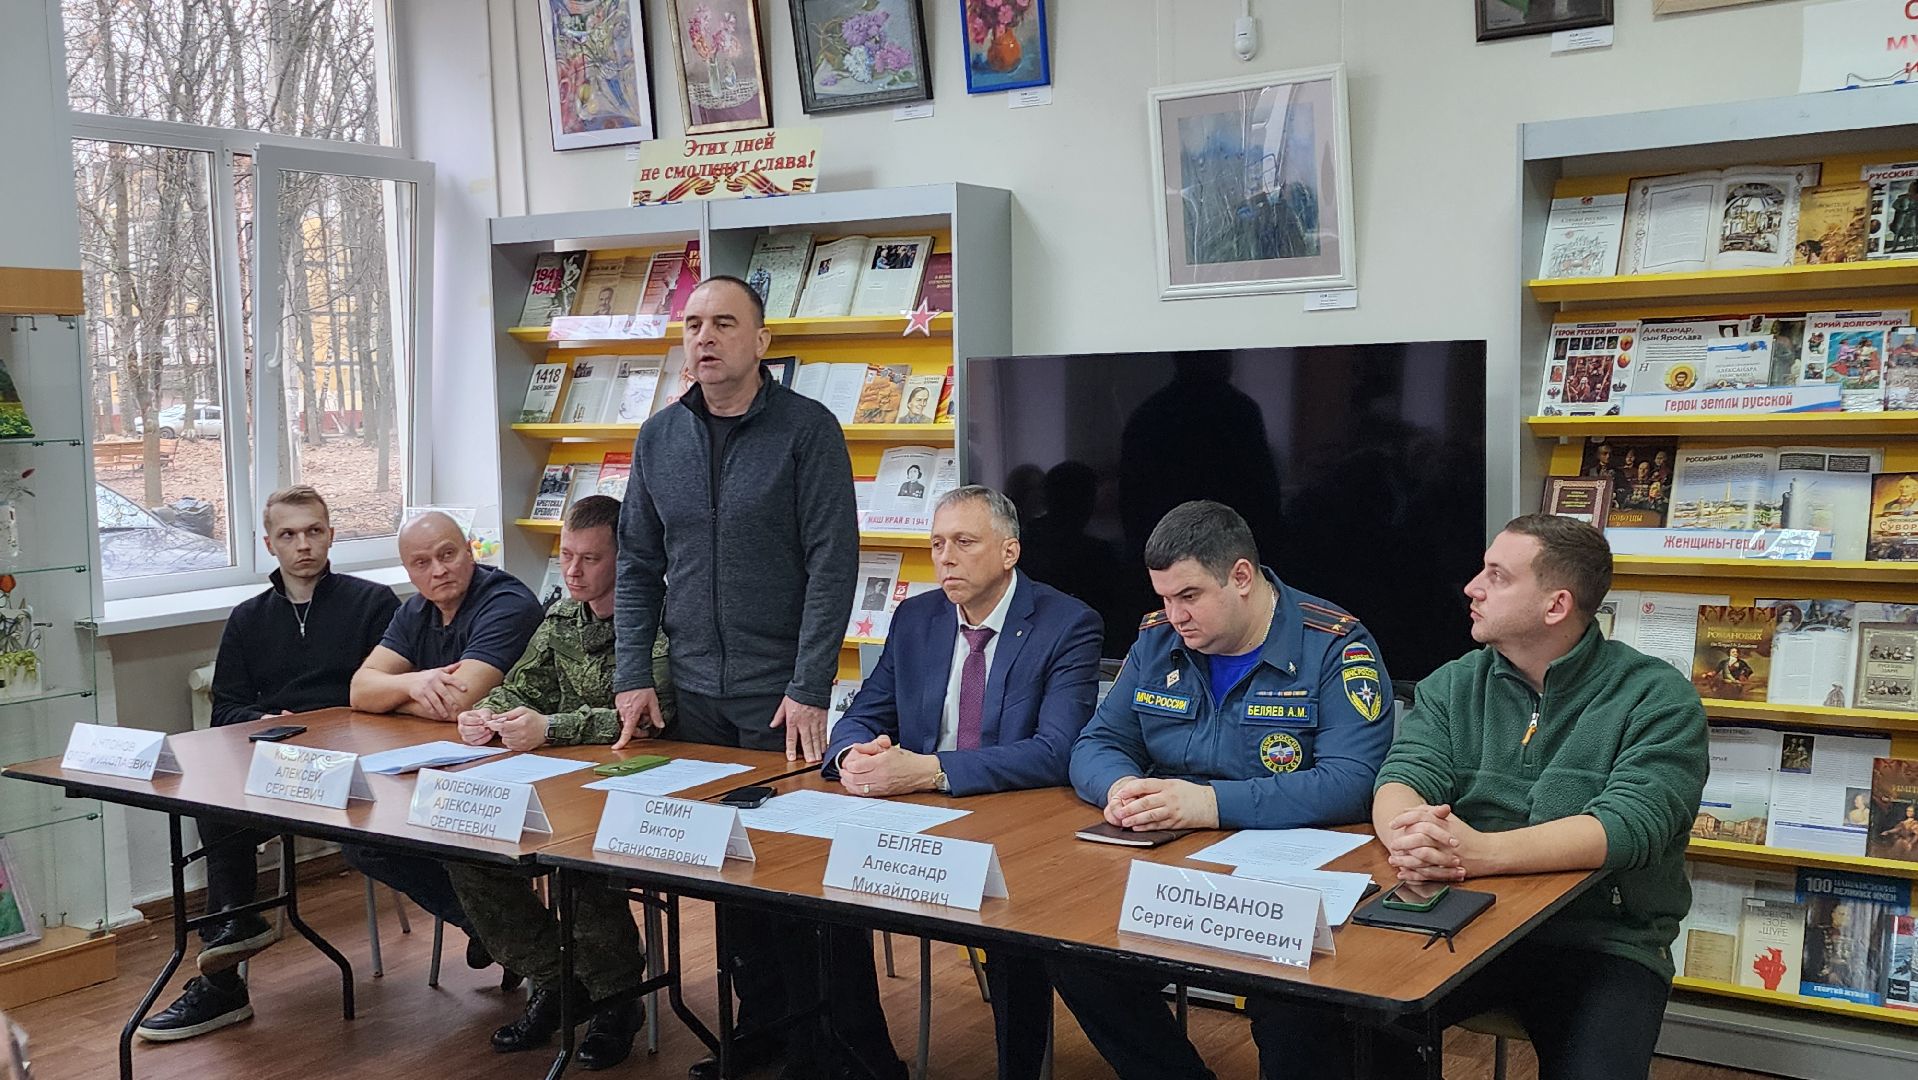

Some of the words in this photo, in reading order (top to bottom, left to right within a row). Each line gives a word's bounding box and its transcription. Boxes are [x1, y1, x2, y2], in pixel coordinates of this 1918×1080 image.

[683, 139, 729, 157] Этих
[731, 132, 776, 156] дней
[640, 168, 660, 182] не
[753, 150, 816, 171] слава!
[1869, 170, 1914, 180] РУССКИЕ
[1555, 329, 1575, 337] ГЕРОИ
[1577, 328, 1604, 336] РУССКОЙ
[1606, 327, 1637, 335] ИСТОРИИ
[1643, 326, 1695, 336] Александр,
[1814, 320, 1841, 328] ЮРИЙ
[1842, 318, 1903, 328] ДОЛГОРУКИЙ
[1660, 334, 1702, 343] Ярослава
[535, 368, 562, 384] 1418
[1665, 399, 1697, 412] Герои
[1700, 397, 1738, 410] земли
[1741, 392, 1793, 409] русской
[1731, 452, 1764, 460] ИМПЕРИЯ
[1707, 631, 1763, 641] РОМАНОВЫХ
[1135, 691, 1154, 705] МЧС
[1155, 694, 1187, 711] РОССИИ
[1247, 705, 1284, 717] БЕЛЯЕВ
[1287, 706, 1308, 718] А.М.
[265, 782, 325, 800] СЕРГЕЕВИЧ
[434, 778, 511, 800] КОЛЕСНИКОВ
[433, 797, 501, 819] АЛЕКСАНДР
[645, 800, 693, 819] СЕМИН
[430, 815, 496, 836] СЕРГЕЕВИЧ
[639, 820, 685, 842] Виктор
[608, 837, 708, 866] Станиславович
[877, 833, 943, 856] БЕЛЯЕВ
[862, 854, 947, 883] Александр
[852, 875, 949, 906] Михайлович
[1805, 876, 1833, 893] 100
[1156, 883, 1284, 920] КОЛЫВАНОВ
[1131, 905, 1194, 931] Сергей
[1200, 917, 1302, 951] Сергеевич
